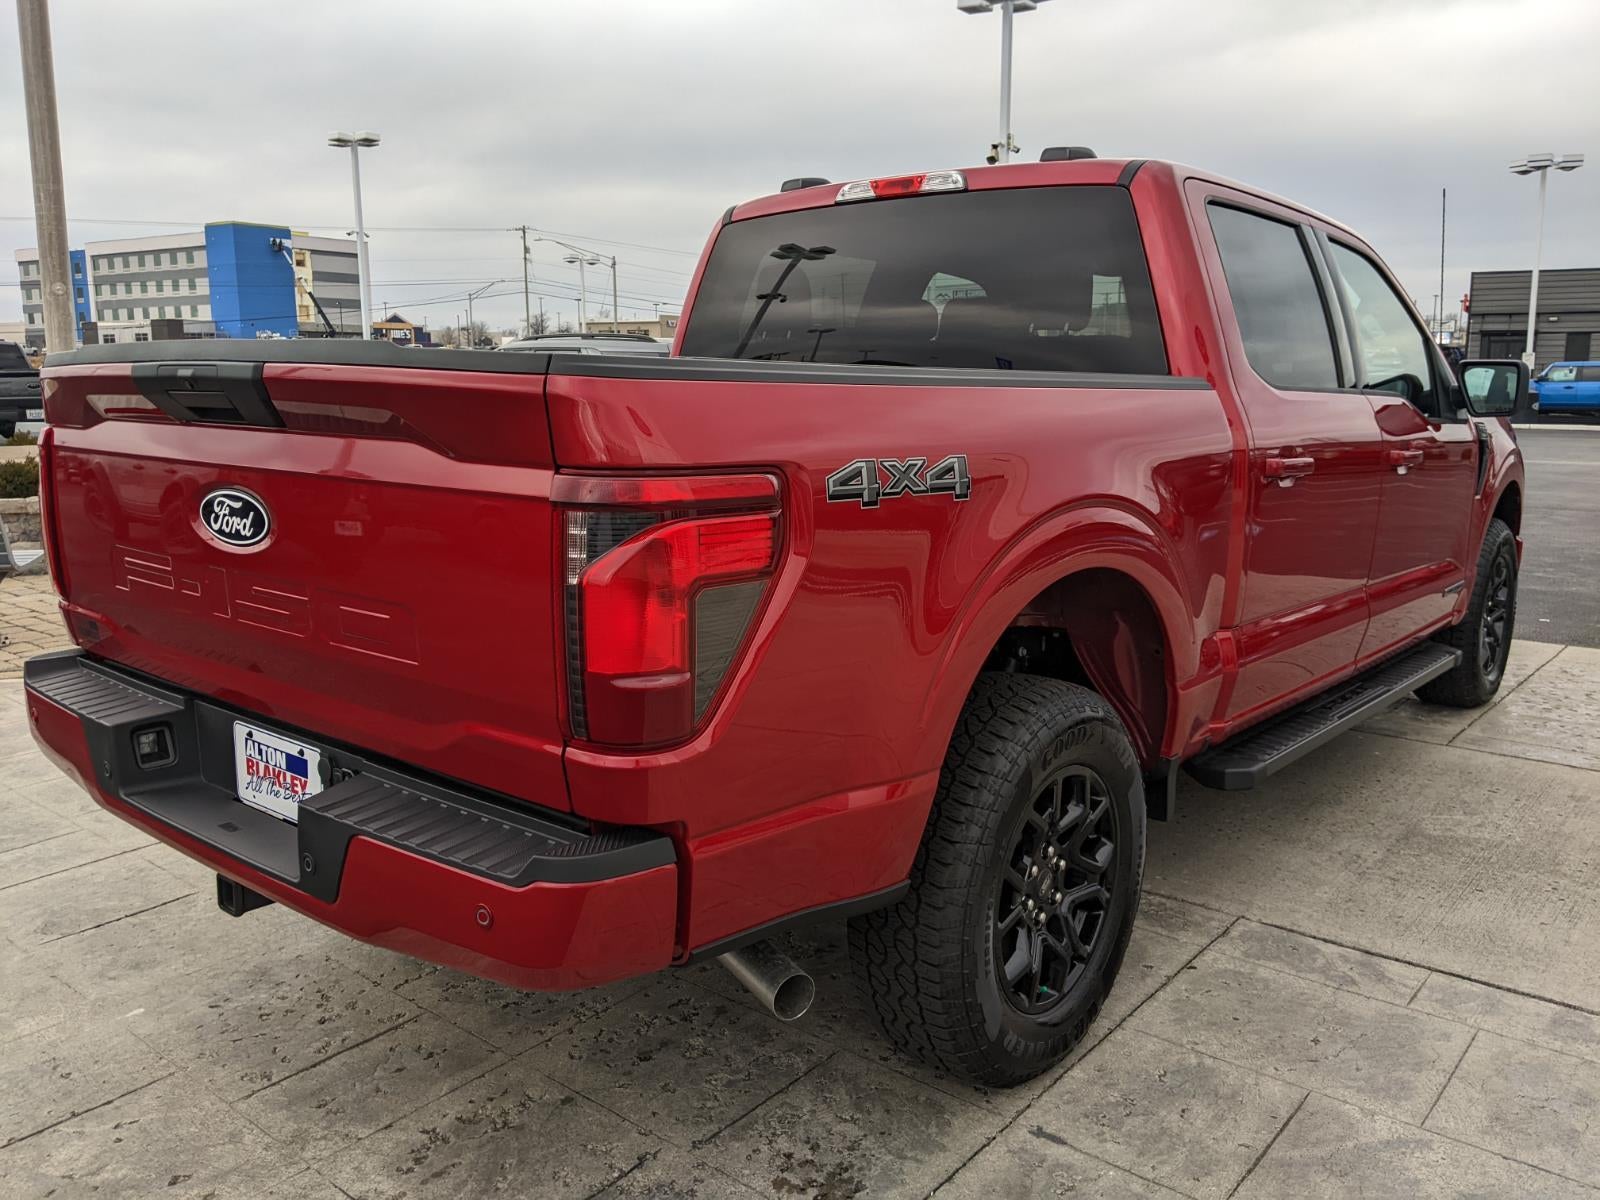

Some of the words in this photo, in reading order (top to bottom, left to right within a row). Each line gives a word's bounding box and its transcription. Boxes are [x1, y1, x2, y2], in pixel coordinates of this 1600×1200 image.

[210, 496, 255, 537] Ford
[246, 739, 287, 771] ALTON
[246, 757, 309, 795] BLAKLEY
[246, 772, 265, 794] All
[265, 776, 282, 798] The
[282, 782, 313, 804] Best
